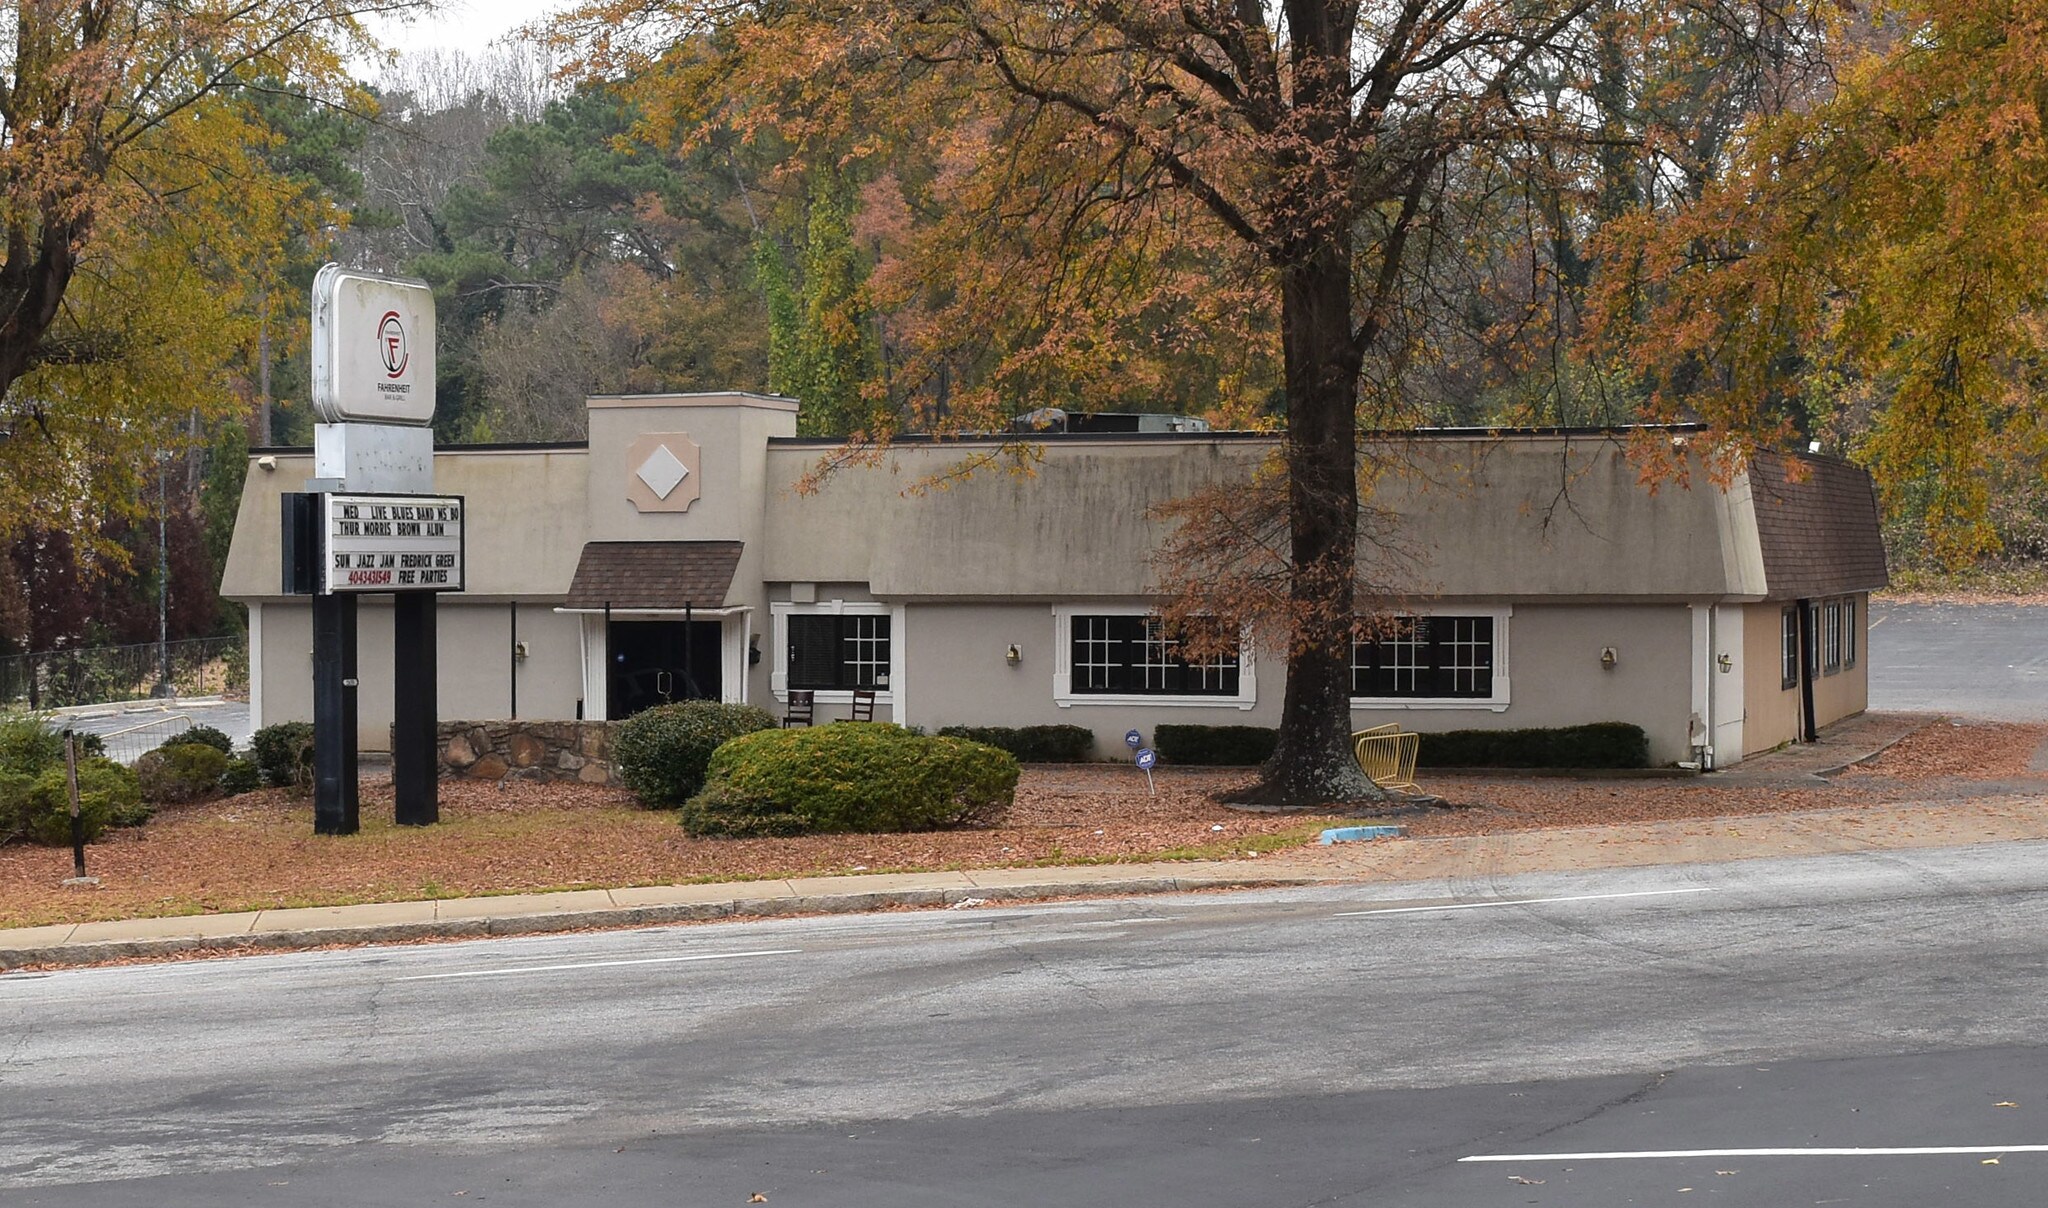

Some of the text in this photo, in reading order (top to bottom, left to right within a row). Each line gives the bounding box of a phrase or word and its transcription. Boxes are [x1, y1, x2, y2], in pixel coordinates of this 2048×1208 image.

[377, 383, 411, 394] FAHRENHEIT
[370, 506, 387, 519] LIVE
[391, 506, 414, 520] BLUES
[416, 507, 434, 520] BAND
[450, 507, 459, 520] BO
[339, 521, 360, 535] THUR
[364, 522, 391, 536] MORRIS
[397, 523, 421, 536] BROWN
[335, 554, 455, 568] SUN JAZZ JAM FREDRICK GREEN
[398, 570, 415, 583] FREE
[420, 570, 448, 583] PARTIES
